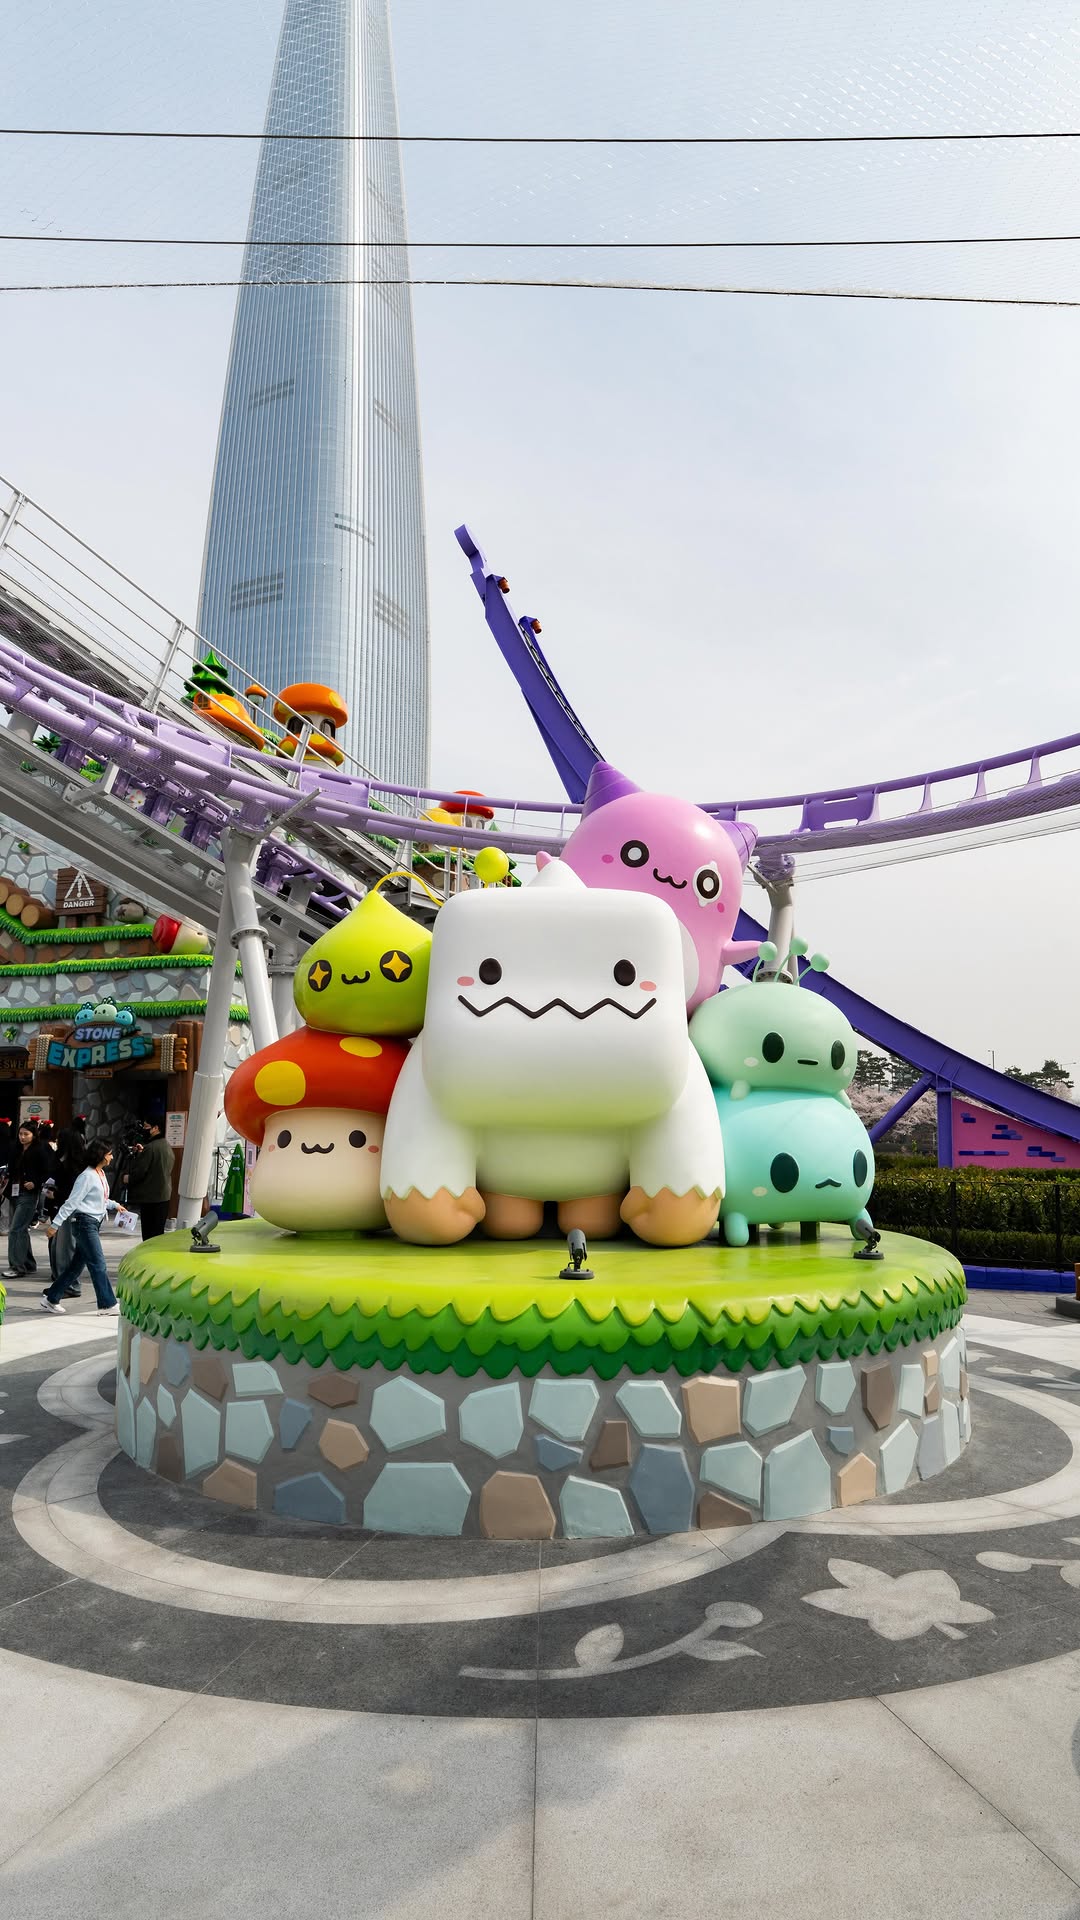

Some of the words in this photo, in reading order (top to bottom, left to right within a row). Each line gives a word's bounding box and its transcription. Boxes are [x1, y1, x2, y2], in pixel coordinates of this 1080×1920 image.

[63, 900, 95, 909] DANGER
[75, 1027, 121, 1040] STONE
[47, 1037, 146, 1069] EXPRESS
